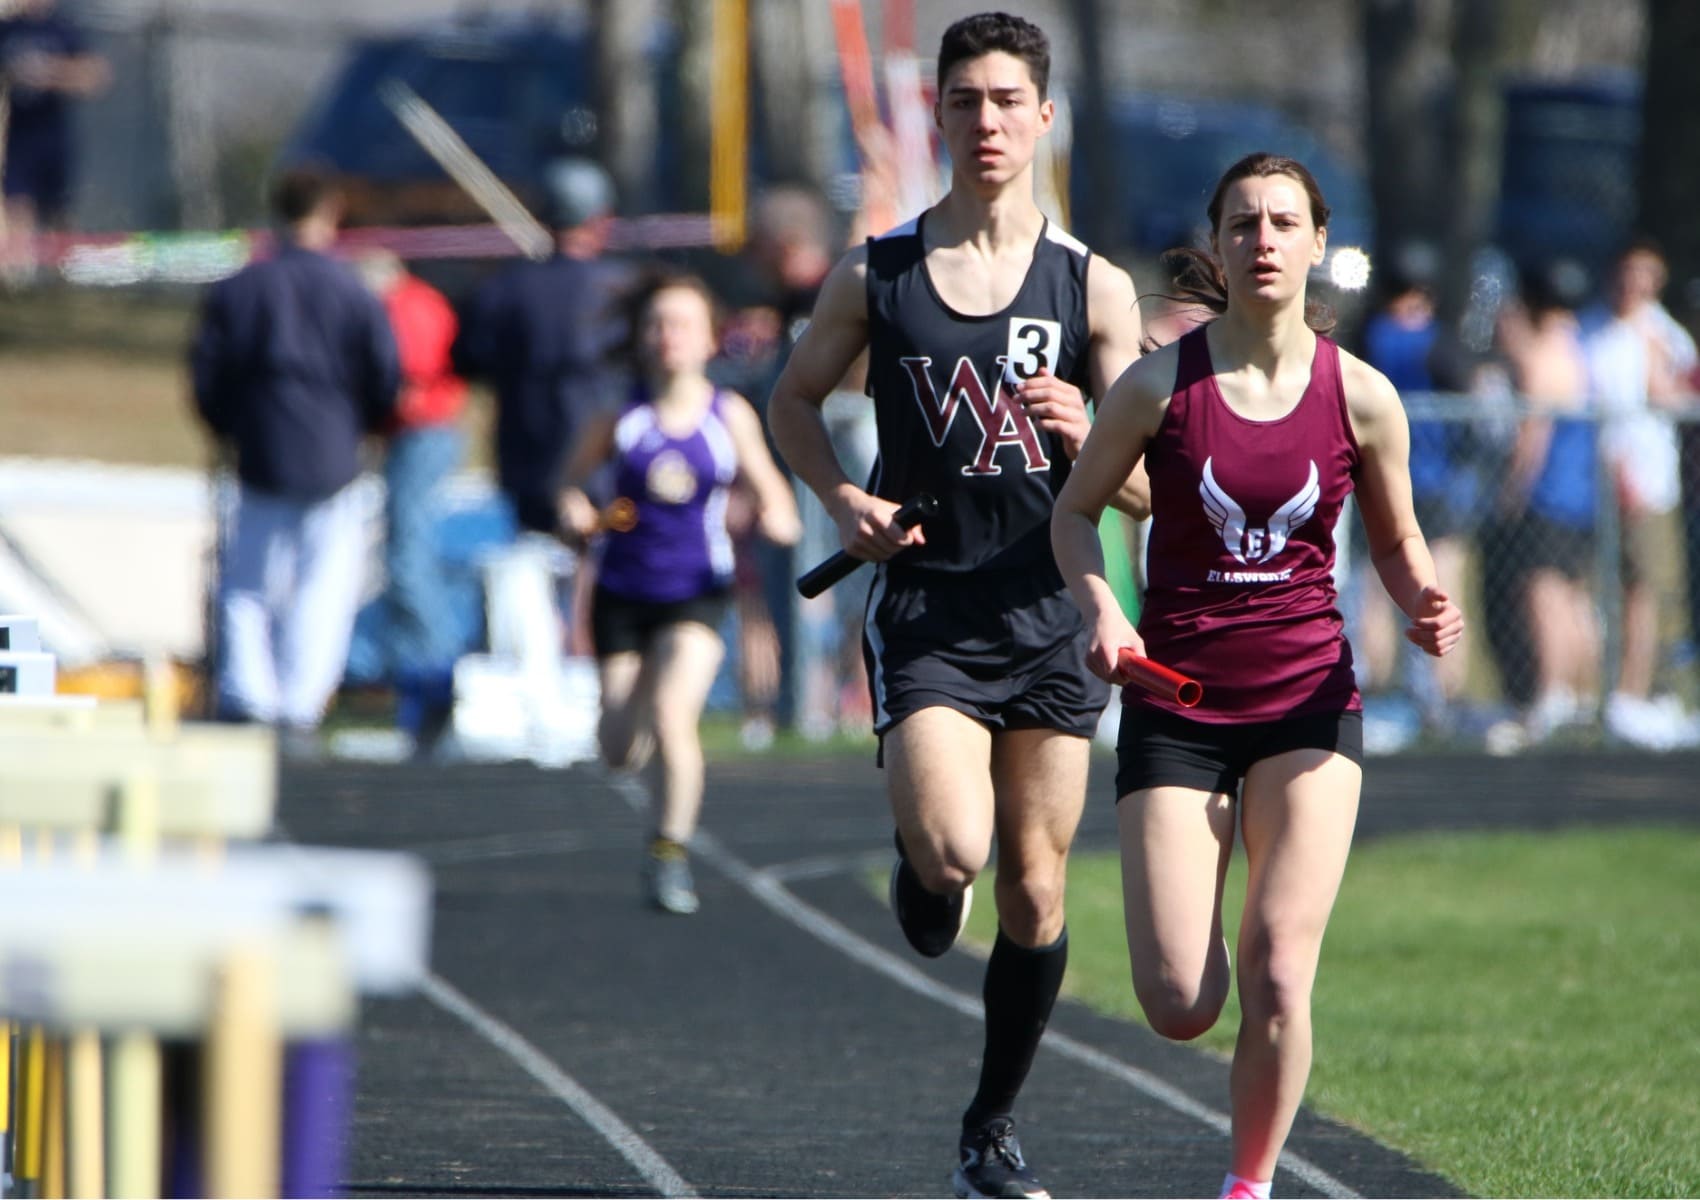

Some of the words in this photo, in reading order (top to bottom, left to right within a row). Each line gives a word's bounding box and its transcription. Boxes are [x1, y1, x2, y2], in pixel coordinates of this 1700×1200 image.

[1013, 323, 1050, 380] 3
[900, 355, 1051, 477] WA
[1246, 528, 1265, 558] E
